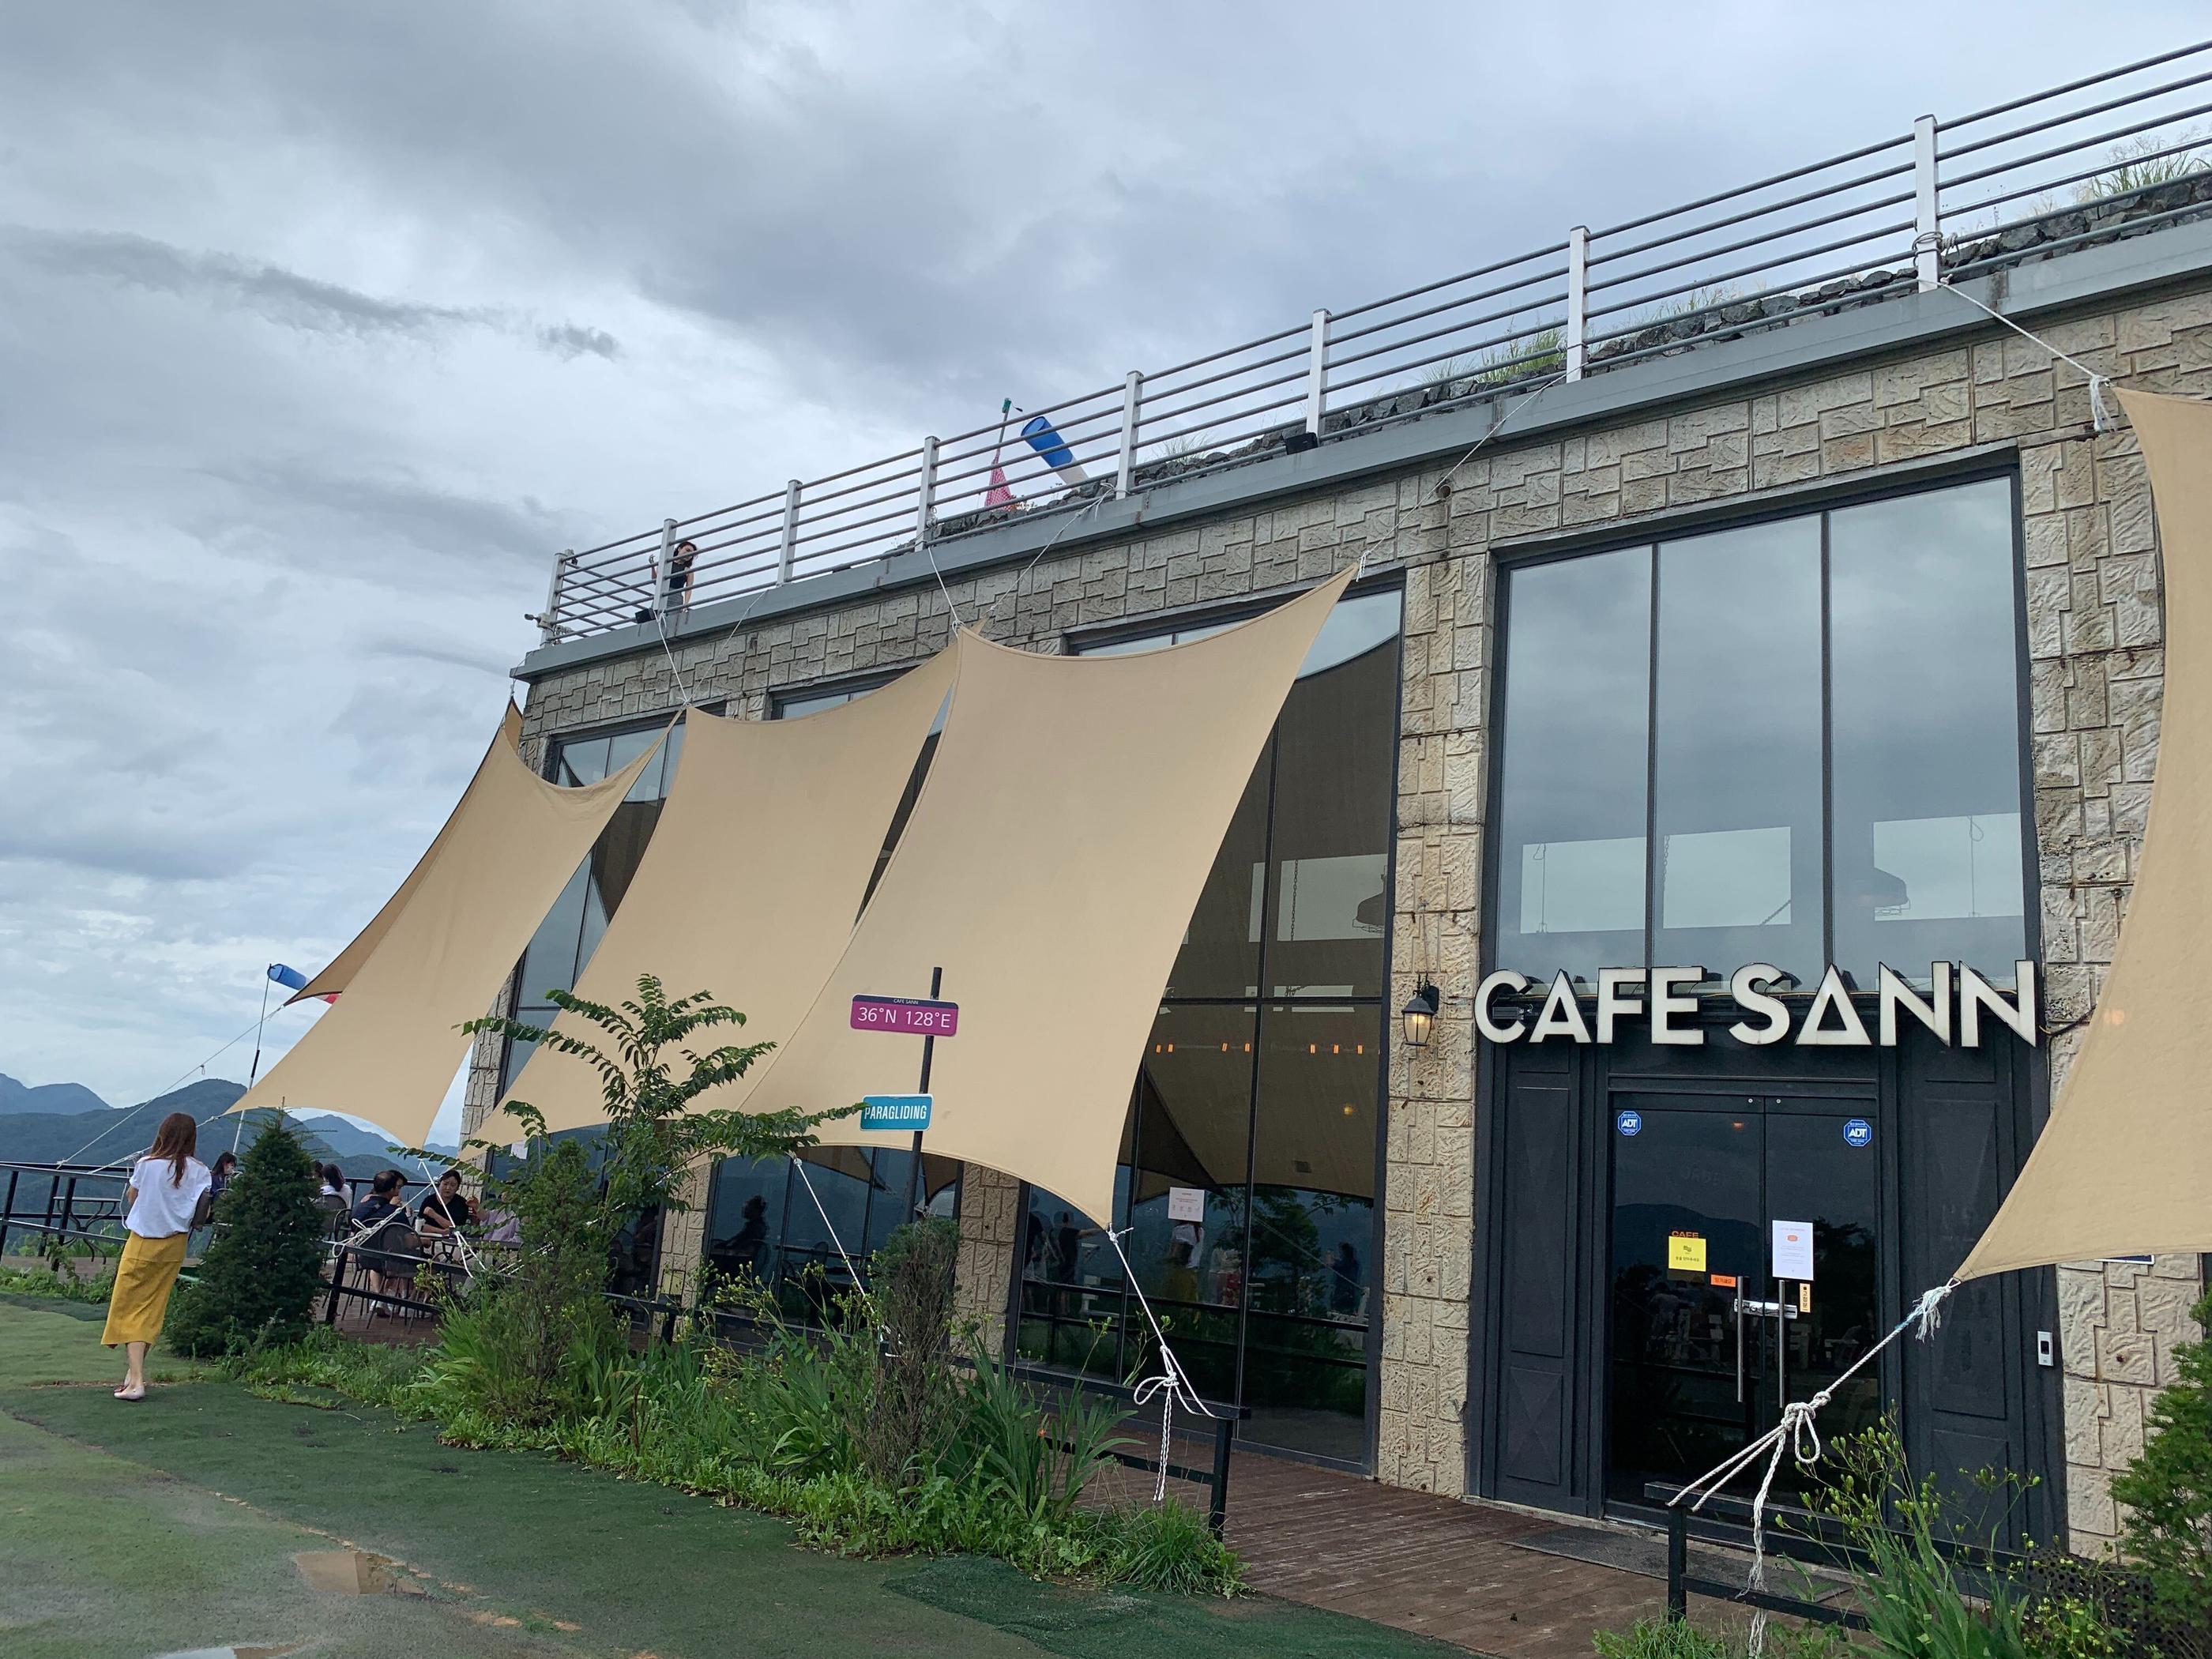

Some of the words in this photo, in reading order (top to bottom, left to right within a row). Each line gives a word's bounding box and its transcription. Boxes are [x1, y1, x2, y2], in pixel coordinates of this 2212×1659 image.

[1473, 965, 1707, 1044] CAFE
[1728, 960, 2038, 1048] SANN
[858, 1006, 897, 1024] 36°N
[905, 1010, 951, 1028] 128°E
[863, 1105, 927, 1119] PARAGLIDING
[1622, 1119, 1638, 1127] ADT
[1848, 1127, 1867, 1138] ADT
[1671, 1230, 1699, 1239] CAFE
